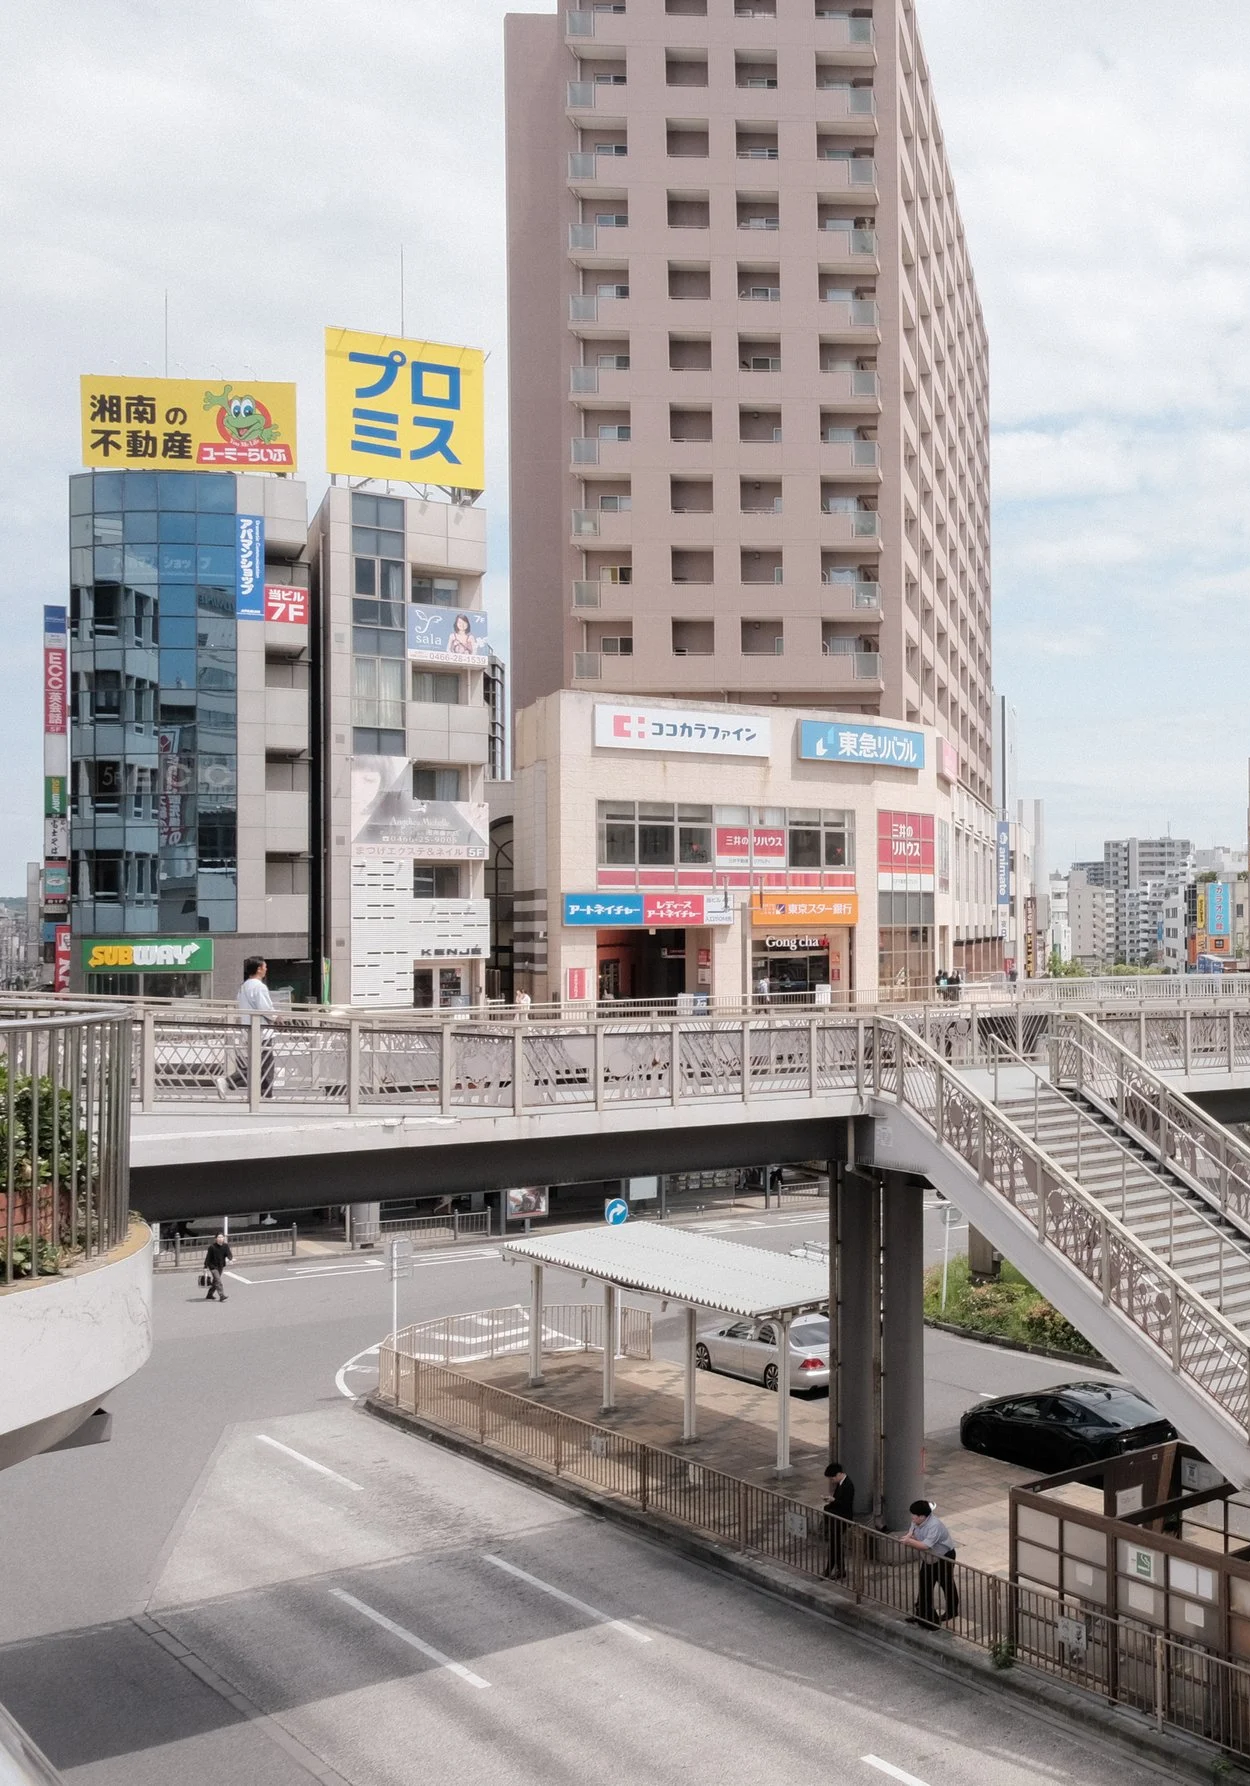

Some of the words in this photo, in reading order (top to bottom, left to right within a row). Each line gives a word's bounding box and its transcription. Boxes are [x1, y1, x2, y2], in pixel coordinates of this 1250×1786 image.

[348, 350, 461, 411] プロ
[89, 394, 188, 427] 湘南の
[90, 429, 193, 460] 不動産
[350, 407, 462, 465] ミス
[202, 447, 287, 462] ユーミーらいふ
[240, 518, 254, 595] アパマンショップ
[268, 589, 305, 602] 当ビル
[268, 602, 304, 622] 7F
[416, 634, 442, 646] sala
[48, 652, 63, 690] ECC
[651, 722, 757, 742] ココカラファイン
[838, 731, 918, 763] 東急リバブル
[51, 778, 60, 813] SUBWAY
[892, 824, 914, 839] 三井の
[468, 848, 484, 857] 5F
[892, 841, 921, 857] リハウス
[999, 847, 1009, 896] animate
[569, 904, 641, 915] アートネイチャー
[647, 909, 702, 919] アートネイチャー
[656, 900, 692, 909] レディース
[788, 903, 853, 915] 東京スター銀行
[766, 936, 797, 951] Gong
[799, 934, 819, 948] cha
[88, 942, 200, 969] SUBWAY
